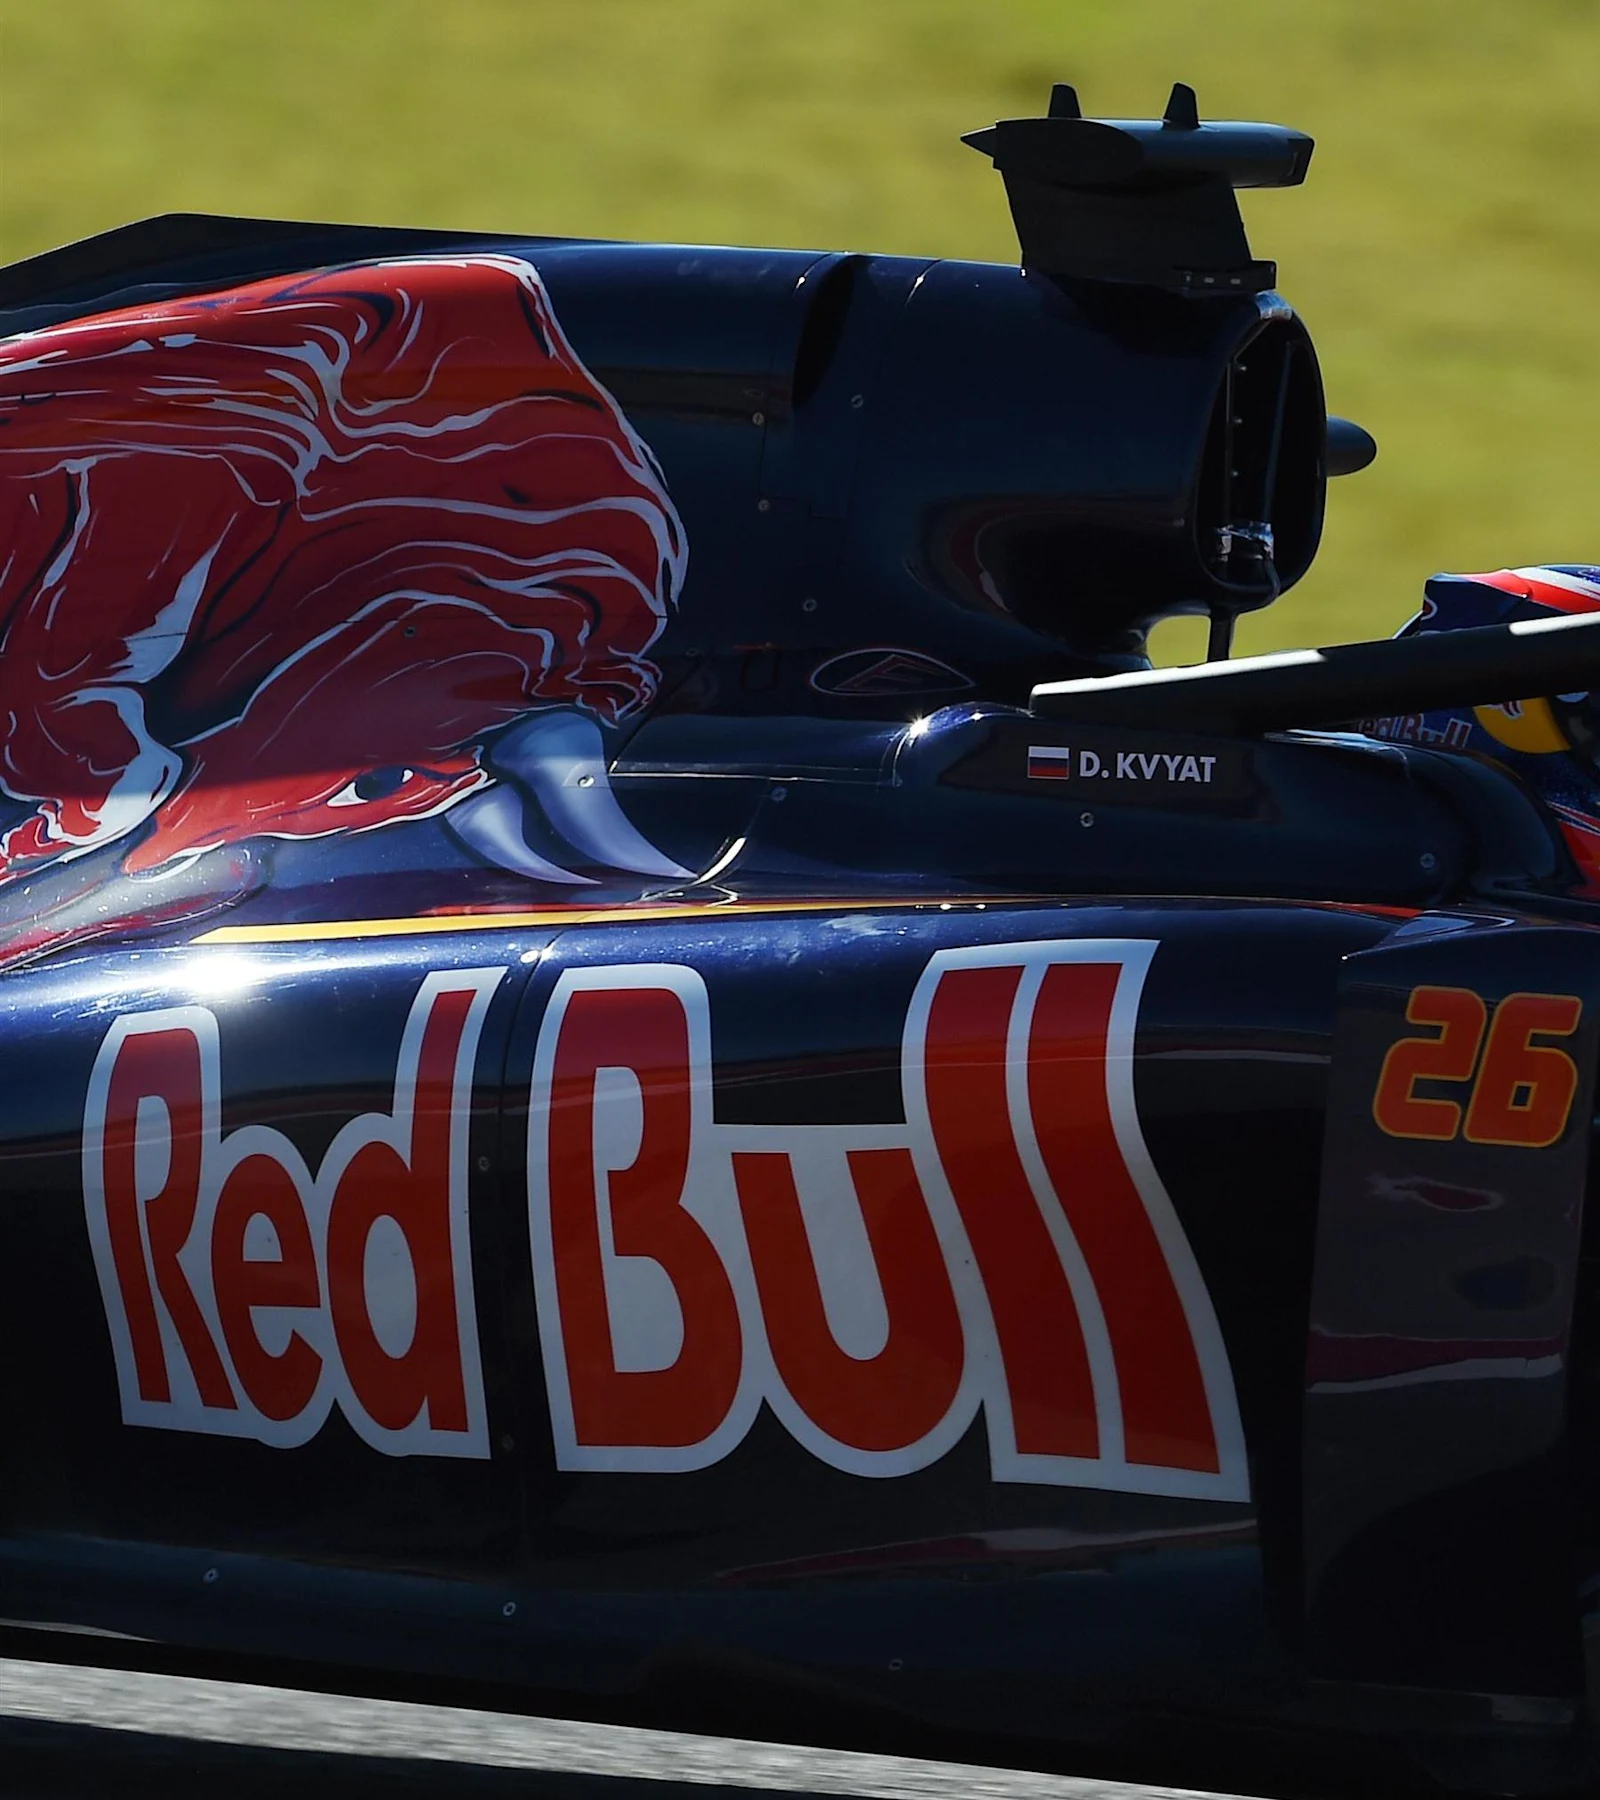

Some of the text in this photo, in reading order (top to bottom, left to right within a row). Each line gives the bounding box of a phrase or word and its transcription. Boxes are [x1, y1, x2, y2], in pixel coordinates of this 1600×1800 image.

[1079, 750, 1217, 783] D. KVYAT
[1372, 985, 1583, 1148] 26
[84, 939, 1249, 1502] Red Bull
